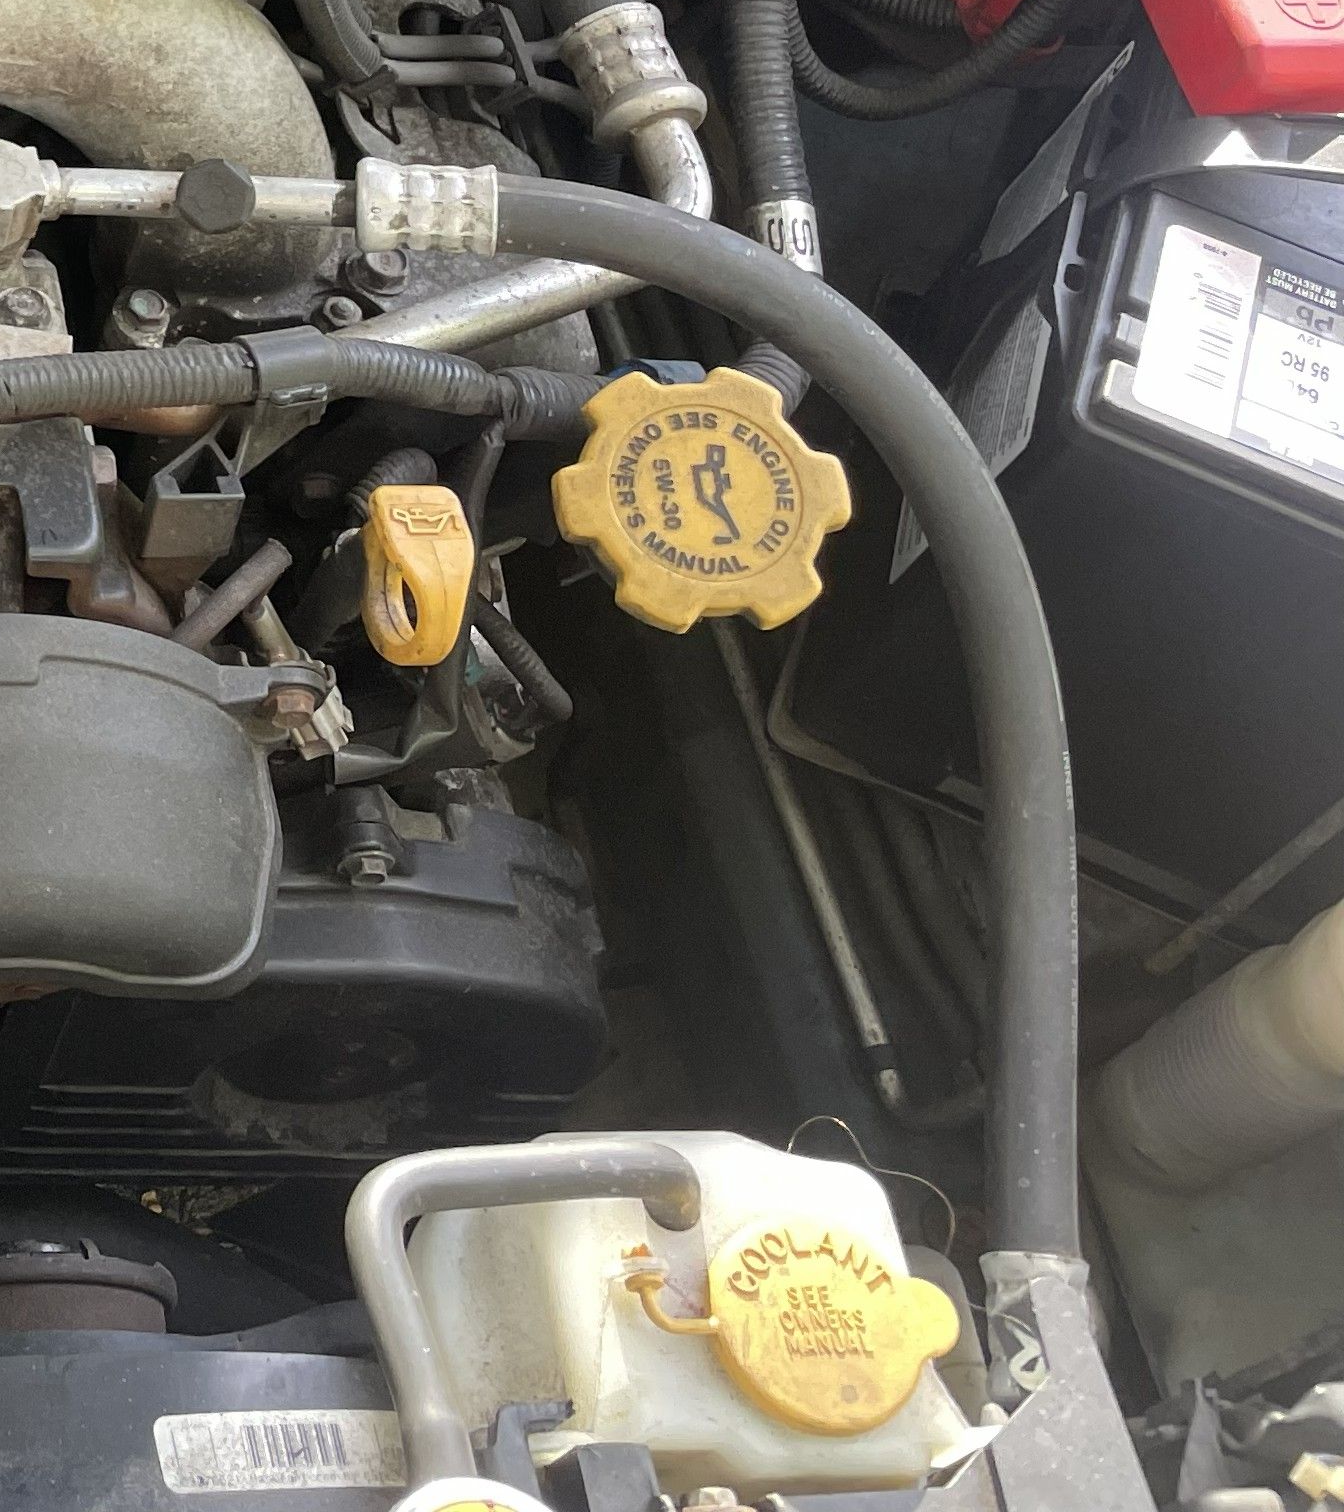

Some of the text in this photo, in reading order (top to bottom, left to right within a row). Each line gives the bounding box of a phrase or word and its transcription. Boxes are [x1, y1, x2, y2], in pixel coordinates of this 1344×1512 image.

[1296, 305, 1335, 332] Pb
[1296, 332, 1323, 349] 12V
[1280, 350, 1331, 383] 95 RC
[614, 411, 750, 576] SEE OWNER'S MANUAL
[652, 458, 683, 531] 5W-30
[731, 422, 795, 554] ENGINE OIL
[726, 1228, 897, 1302] COOLANT
[785, 1285, 833, 1310] SEE
[784, 1334, 875, 1362] MANUAL
